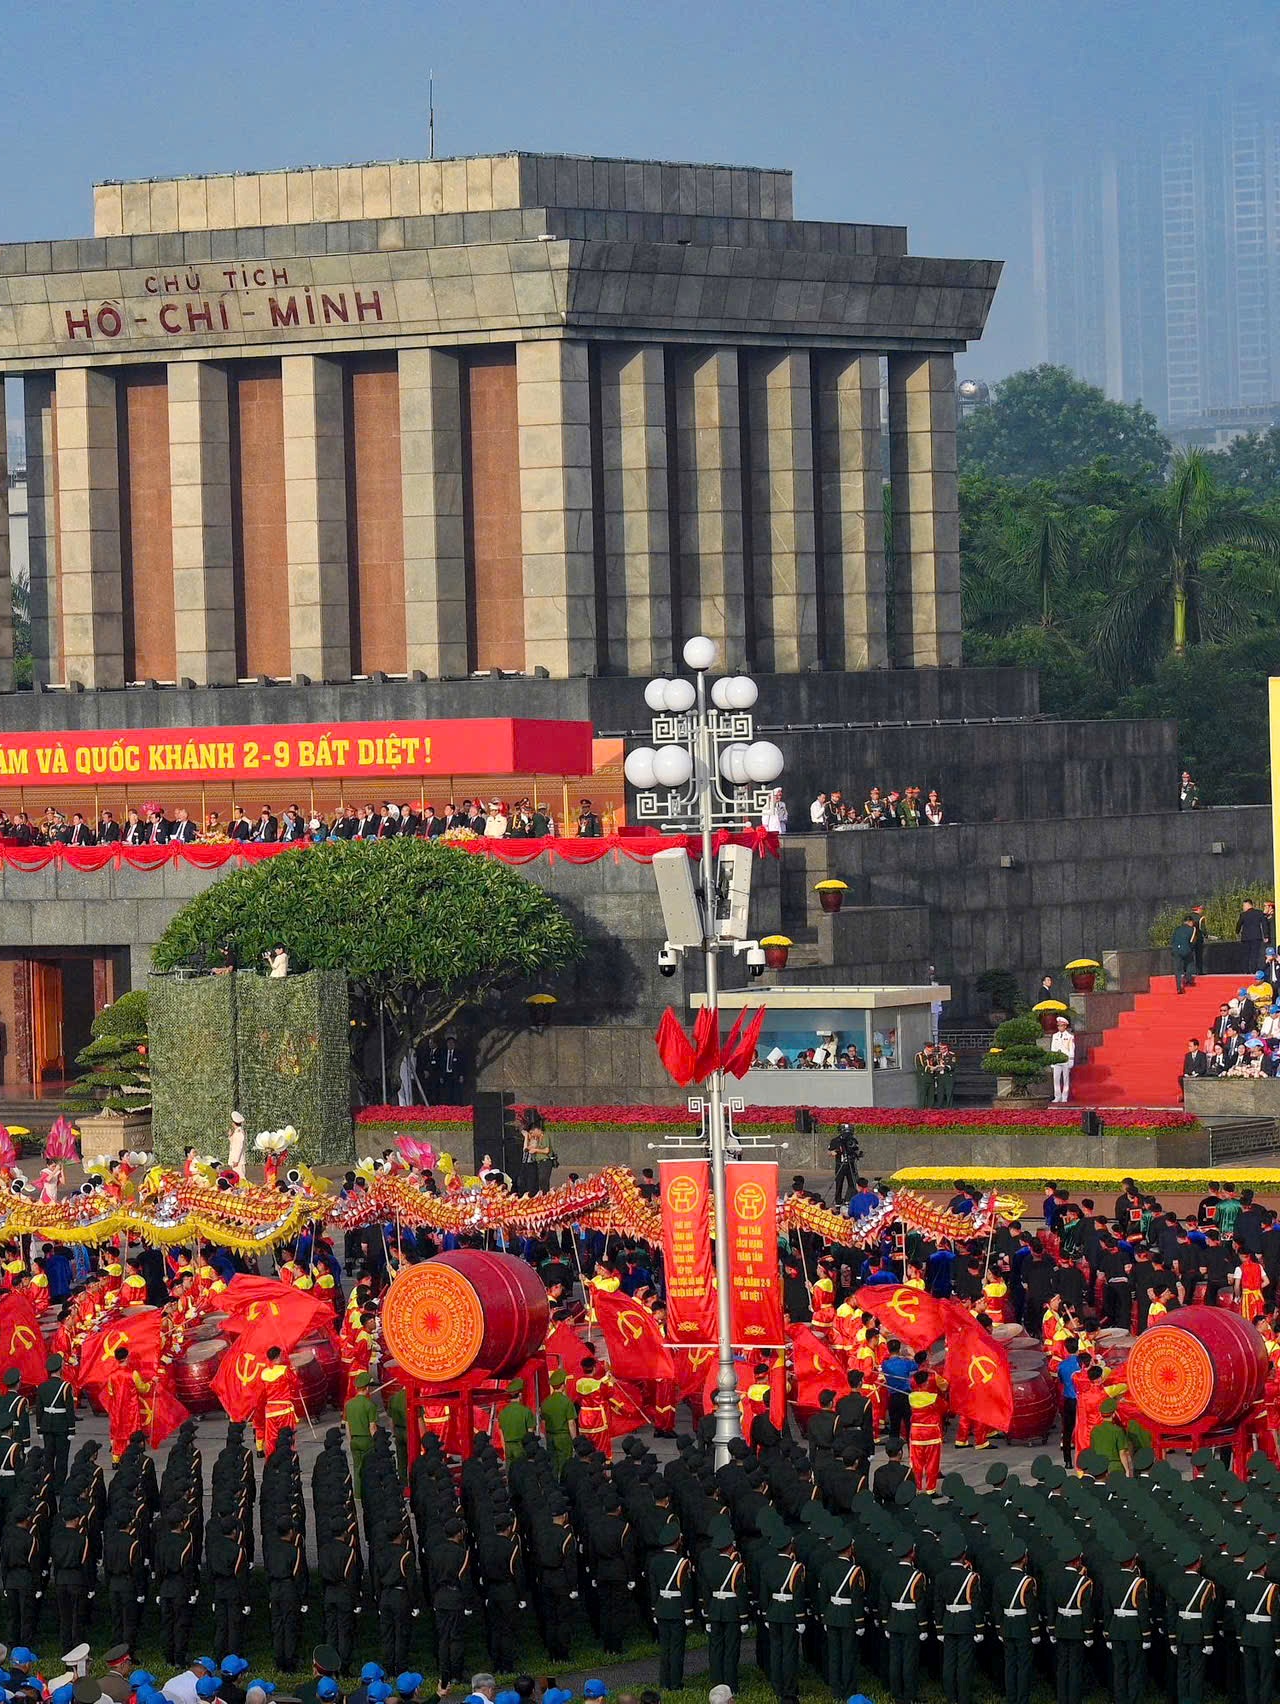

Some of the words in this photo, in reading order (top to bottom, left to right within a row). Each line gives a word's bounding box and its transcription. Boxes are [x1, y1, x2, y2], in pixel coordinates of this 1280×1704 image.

[144, 266, 200, 294] CHỦ
[223, 264, 289, 295] TỊCH
[35, 742, 69, 774] VÀ
[75, 737, 140, 775] QUỐC
[148, 738, 235, 771] KHÁNH
[298, 731, 350, 767] BẤT
